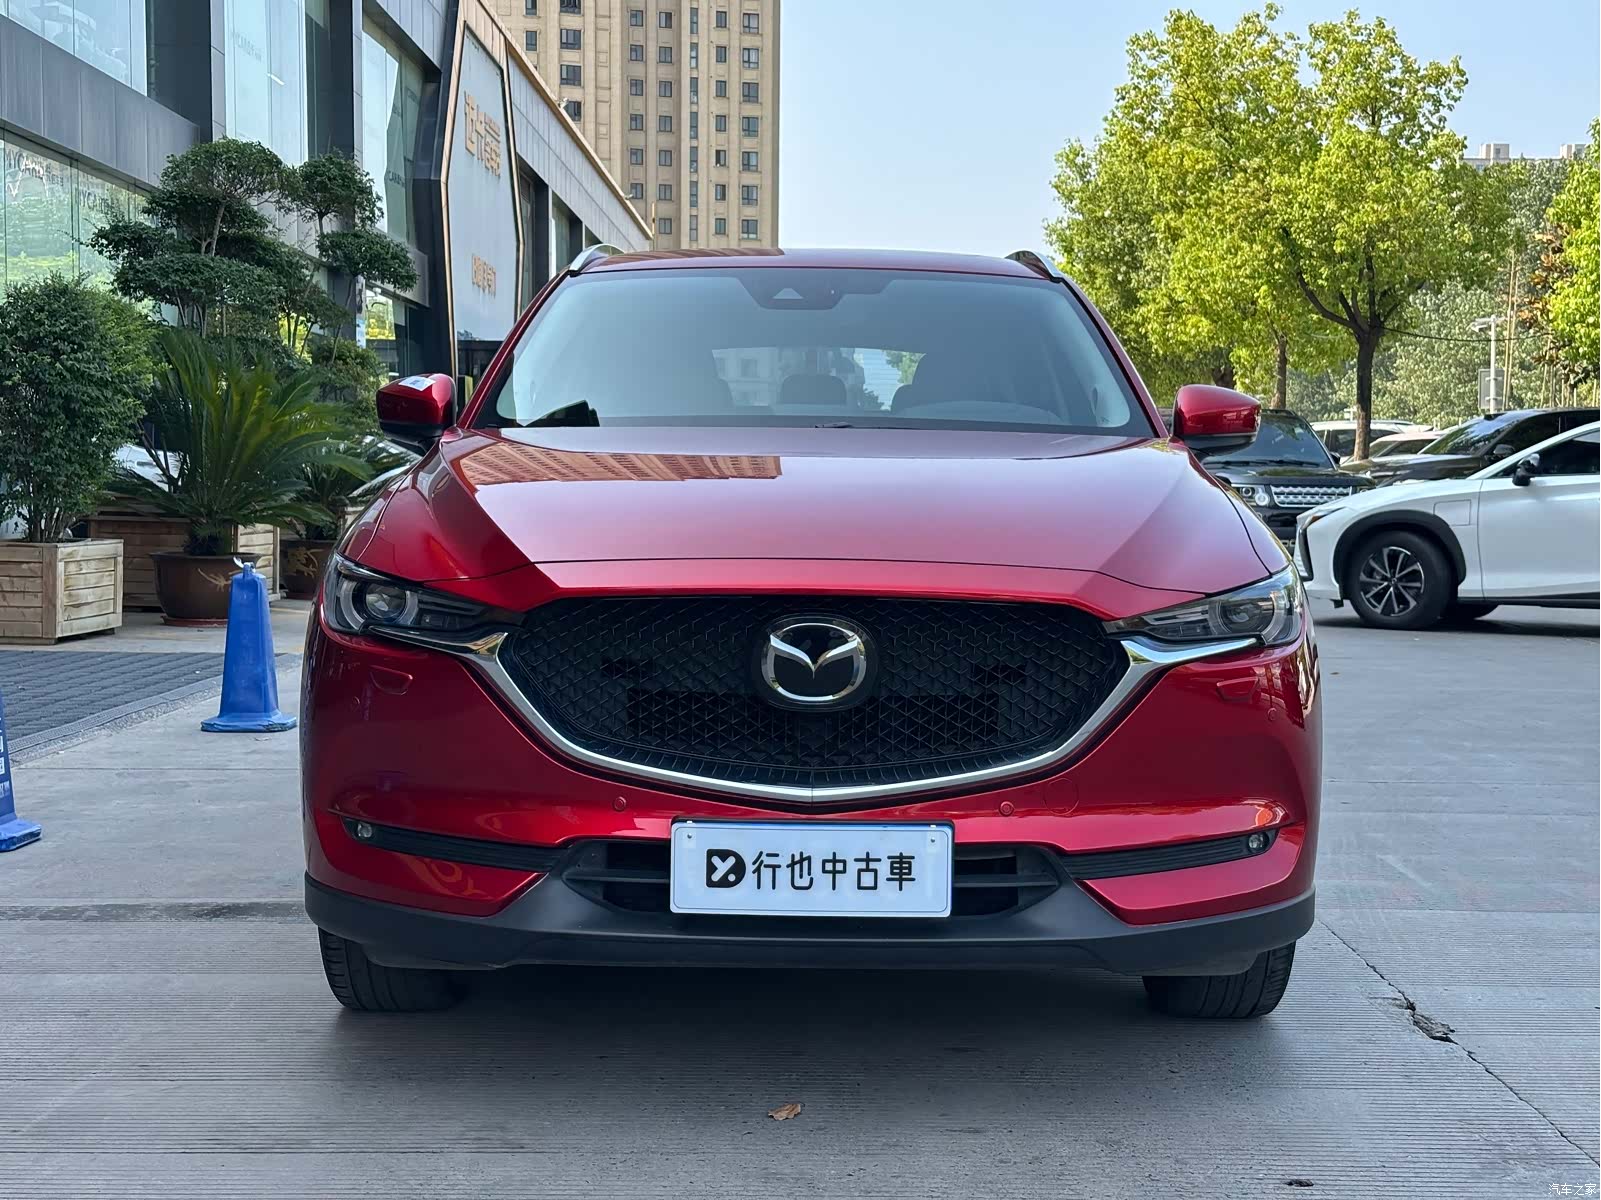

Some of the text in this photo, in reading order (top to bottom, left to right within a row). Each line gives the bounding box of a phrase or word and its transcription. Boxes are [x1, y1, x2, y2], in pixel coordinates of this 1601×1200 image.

[752, 851, 916, 891] 行也中古車
